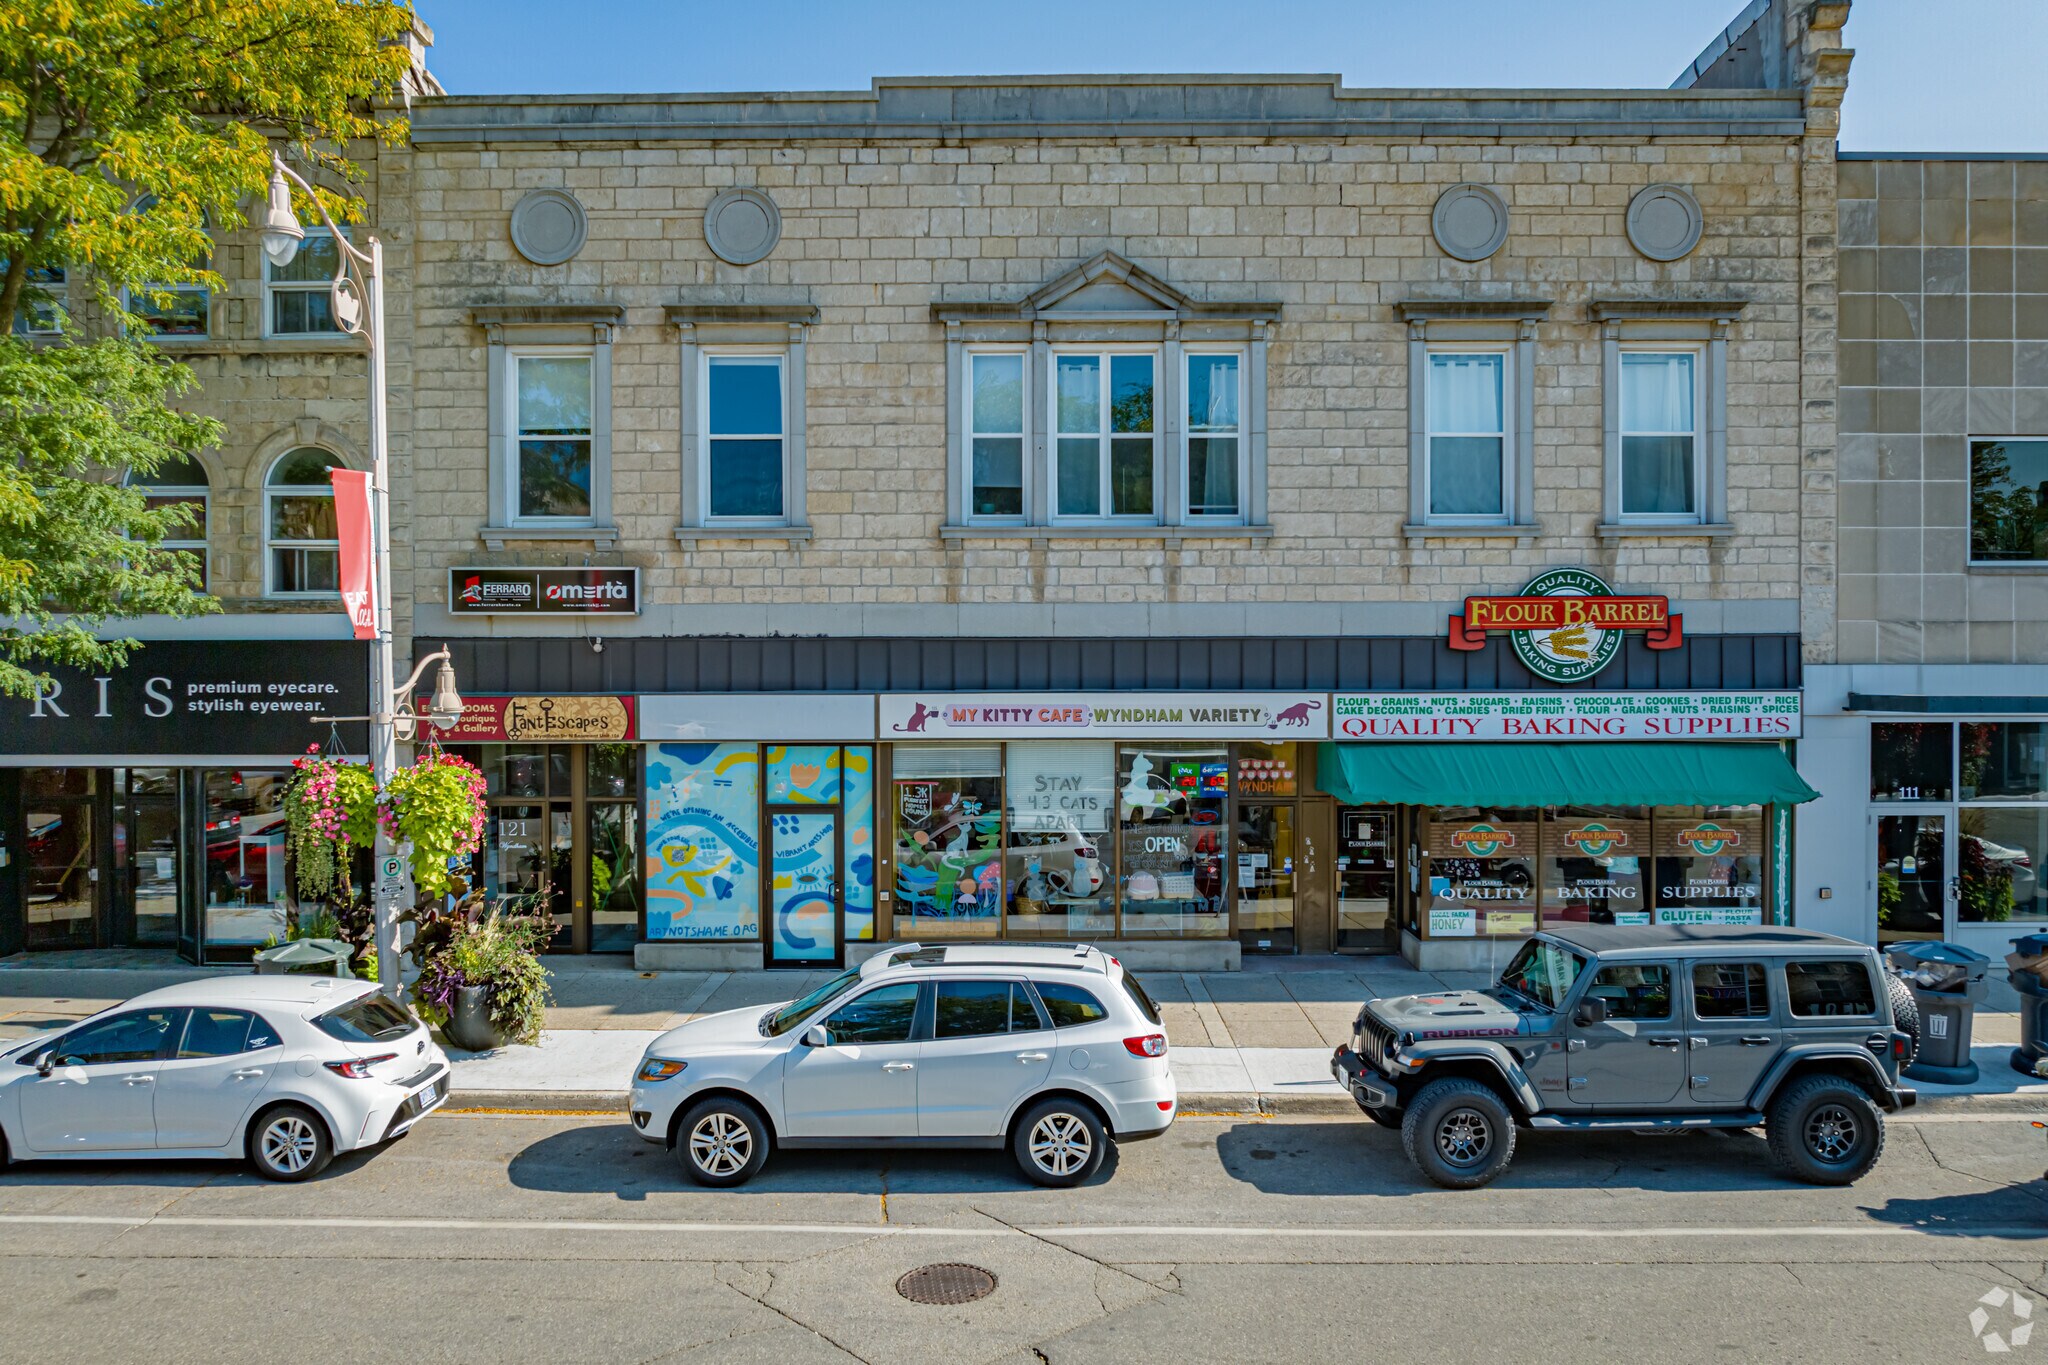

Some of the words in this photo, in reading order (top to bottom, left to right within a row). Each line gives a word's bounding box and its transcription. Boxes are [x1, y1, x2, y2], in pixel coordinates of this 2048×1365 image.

[483, 584, 531, 596] FERRARO
[1536, 575, 1599, 592] QUALITY
[345, 591, 368, 606] EAT
[1470, 599, 1555, 626] FLOUR
[1563, 599, 1665, 626] BARREL
[1518, 636, 1556, 674] BAKING
[1561, 635, 1616, 676] SUPPLIES
[187, 681, 262, 695] premium
[267, 682, 339, 696] eyecare.
[187, 698, 244, 713] stylish
[250, 701, 325, 713] eyewear.
[1337, 697, 1370, 706] FLOUR
[1381, 697, 1420, 706] GRAINS
[1430, 697, 1458, 706] NUTS
[1468, 697, 1511, 706] SUGARS
[1521, 697, 1563, 706] RAISINS
[1573, 697, 1634, 706] CHOCOLATE
[1645, 696, 1690, 705] COOKIES
[1701, 696, 1732, 705] DRIED
[1734, 696, 1764, 705] FRUIT
[1774, 696, 1799, 705] RICE
[464, 704, 497, 713] OOMS,
[952, 708, 978, 722] MY
[982, 708, 1033, 722] KITTY
[1037, 708, 1083, 722] CAFE
[1093, 708, 1183, 722] WYNDHAM
[1189, 708, 1261, 722] VARIETY
[1336, 706, 1364, 715] CAKE
[1367, 706, 1433, 715] DECORATING
[1444, 706, 1490, 715] CANDIES
[1501, 706, 1533, 715] DRIED
[1535, 706, 1566, 715] FRUIT
[1577, 705, 1610, 714] FLOUR
[1621, 705, 1660, 714] GRAINS
[1671, 705, 1699, 714] NUTS
[1710, 705, 1751, 714] RAISINS
[1762, 704, 1799, 714] SPICES
[460, 714, 497, 724] outique,
[463, 724, 498, 734] Gallery
[1342, 717, 1484, 737] QUALITY
[1501, 717, 1628, 735] BAKING
[1644, 716, 1790, 735] SUPPLIES
[1035, 774, 1082, 793] STAY
[904, 786, 929, 798] 1.3K
[1899, 786, 1920, 800] 111
[1060, 796, 1098, 811] CATS
[660, 808, 681, 821] WE'RE
[683, 807, 712, 817] OPENING
[712, 813, 725, 822] AN
[1034, 813, 1086, 830] APART
[499, 821, 527, 837] 121
[776, 844, 807, 858] VIBRANT
[808, 833, 822, 848] ARTS
[1144, 836, 1181, 853] OPEN
[389, 862, 397, 873] P
[1439, 887, 1530, 901] QUALITY
[1557, 886, 1638, 899] BAKING
[1662, 886, 1756, 899] SUPPLIES
[1661, 910, 1712, 921] GLUTEN
[649, 923, 758, 938] ARTNOTSHAME.ORG
[1431, 918, 1465, 930] HONEY
[1422, 1028, 1519, 1038] RUBICON
